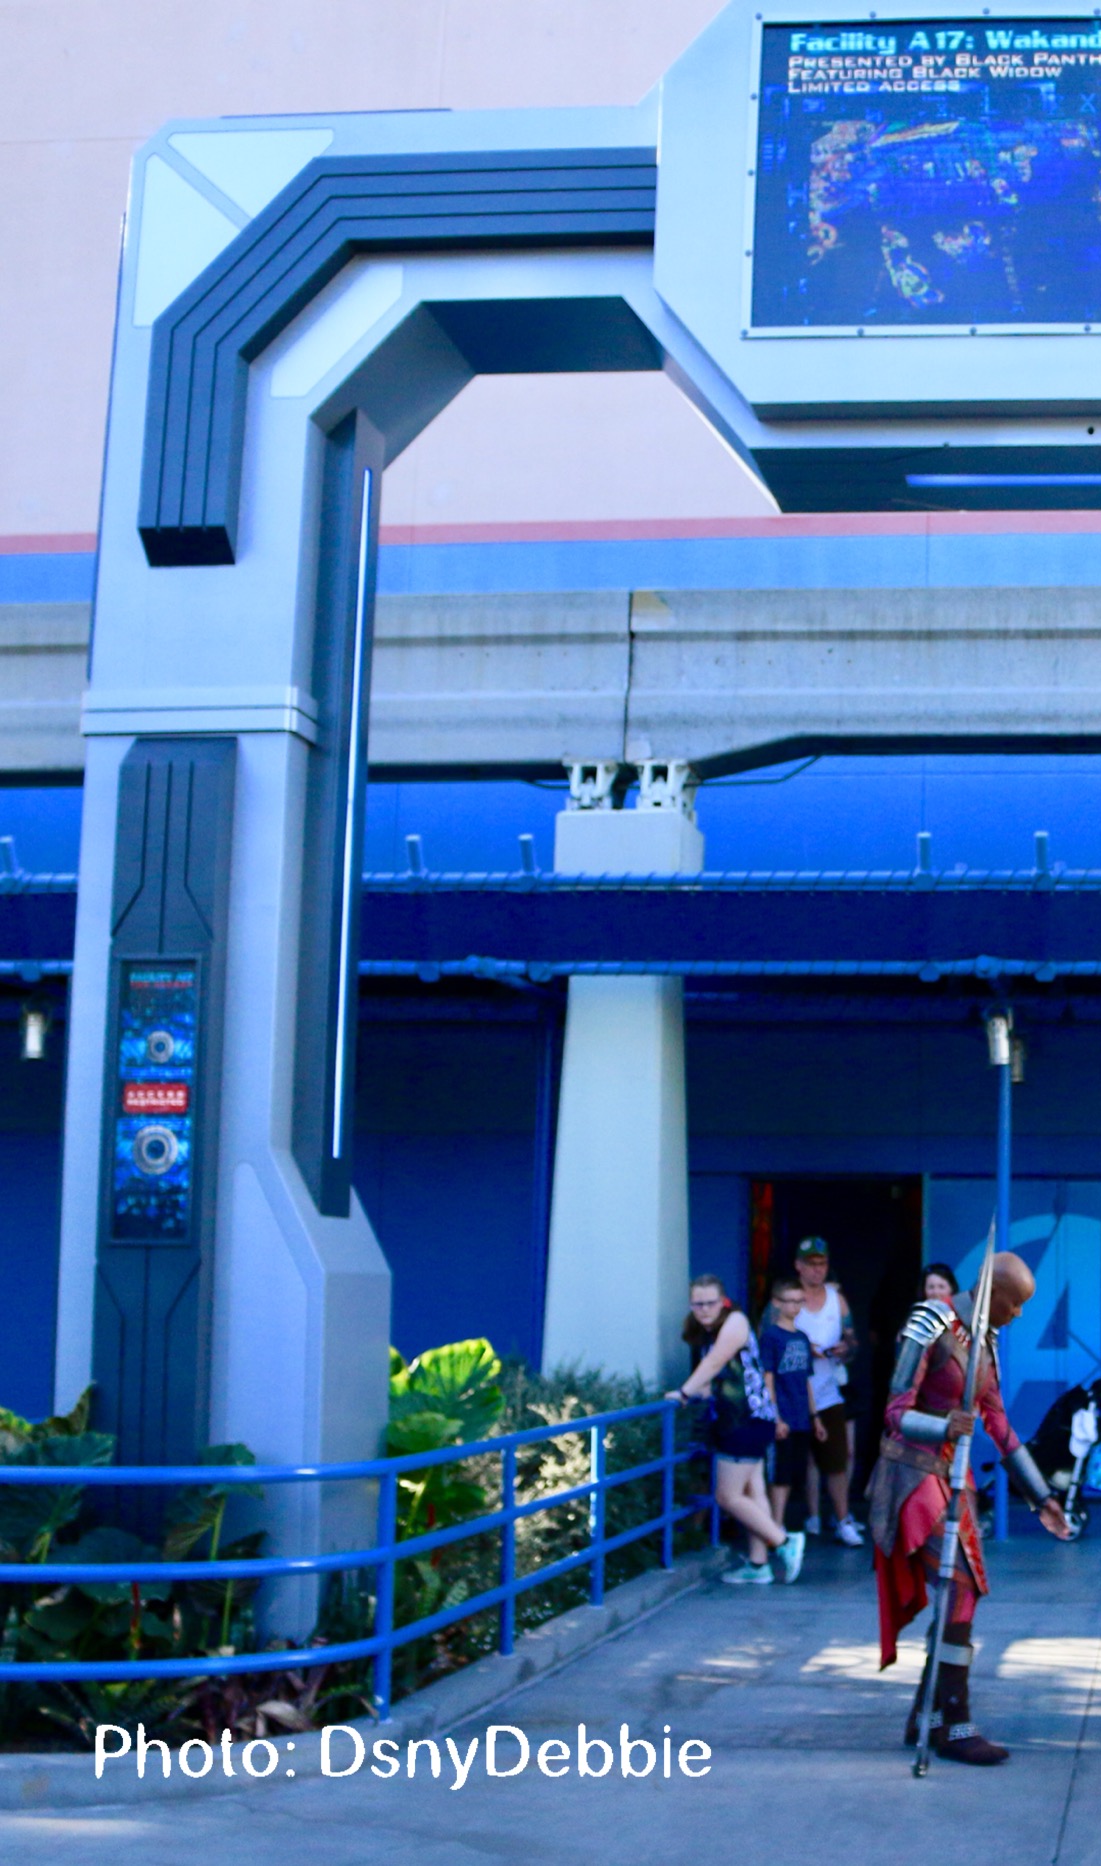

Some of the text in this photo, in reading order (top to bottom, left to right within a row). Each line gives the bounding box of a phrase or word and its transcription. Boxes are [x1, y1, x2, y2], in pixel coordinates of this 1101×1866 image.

[790, 32, 897, 55] Facility
[788, 55, 913, 68] PRESENTED
[921, 55, 947, 67] BY
[955, 53, 1024, 66] BLACK
[788, 65, 1062, 80] FEATURING BLACK WIDOW
[788, 80, 961, 93] LIMITED ACCESS
